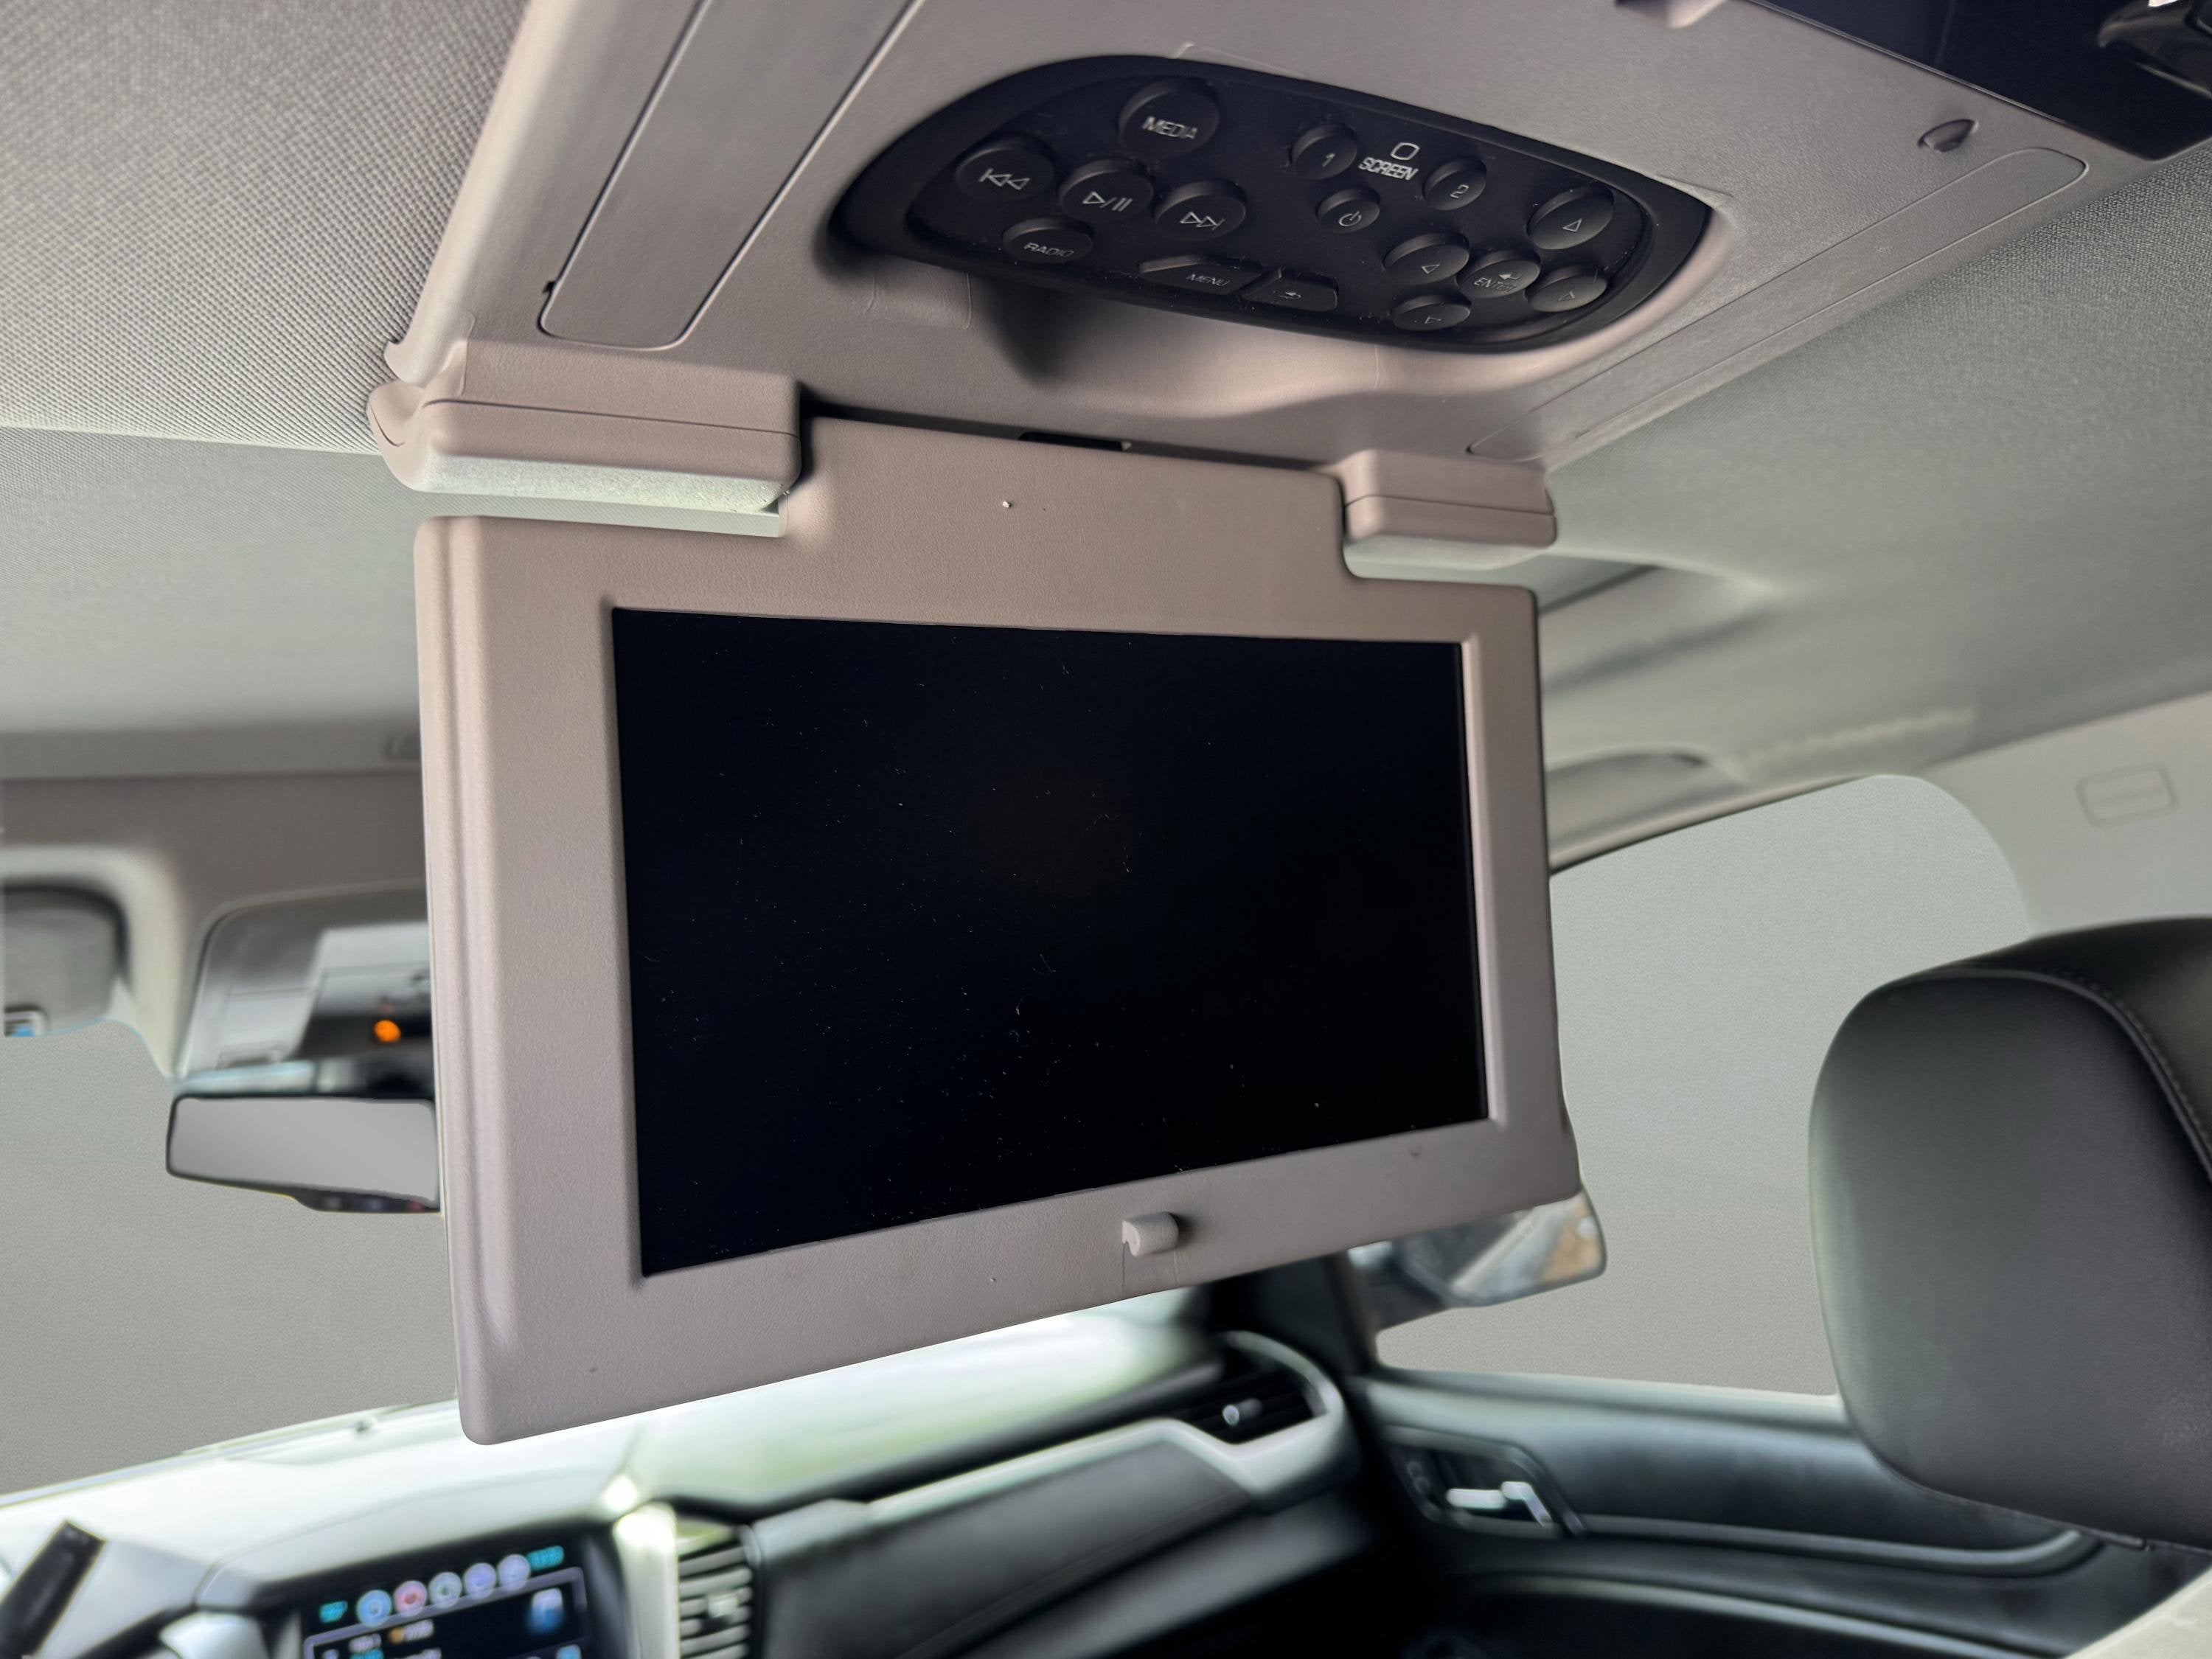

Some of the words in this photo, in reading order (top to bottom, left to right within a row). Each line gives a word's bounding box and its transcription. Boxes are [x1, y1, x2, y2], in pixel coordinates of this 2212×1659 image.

[1142, 116, 1198, 139] MEDIA
[1322, 153, 1336, 168] 1
[1358, 156, 1419, 181] SCREEN
[1450, 184, 1470, 199] 2
[1023, 242, 1075, 258] RADIO
[1185, 274, 1231, 287] MENU
